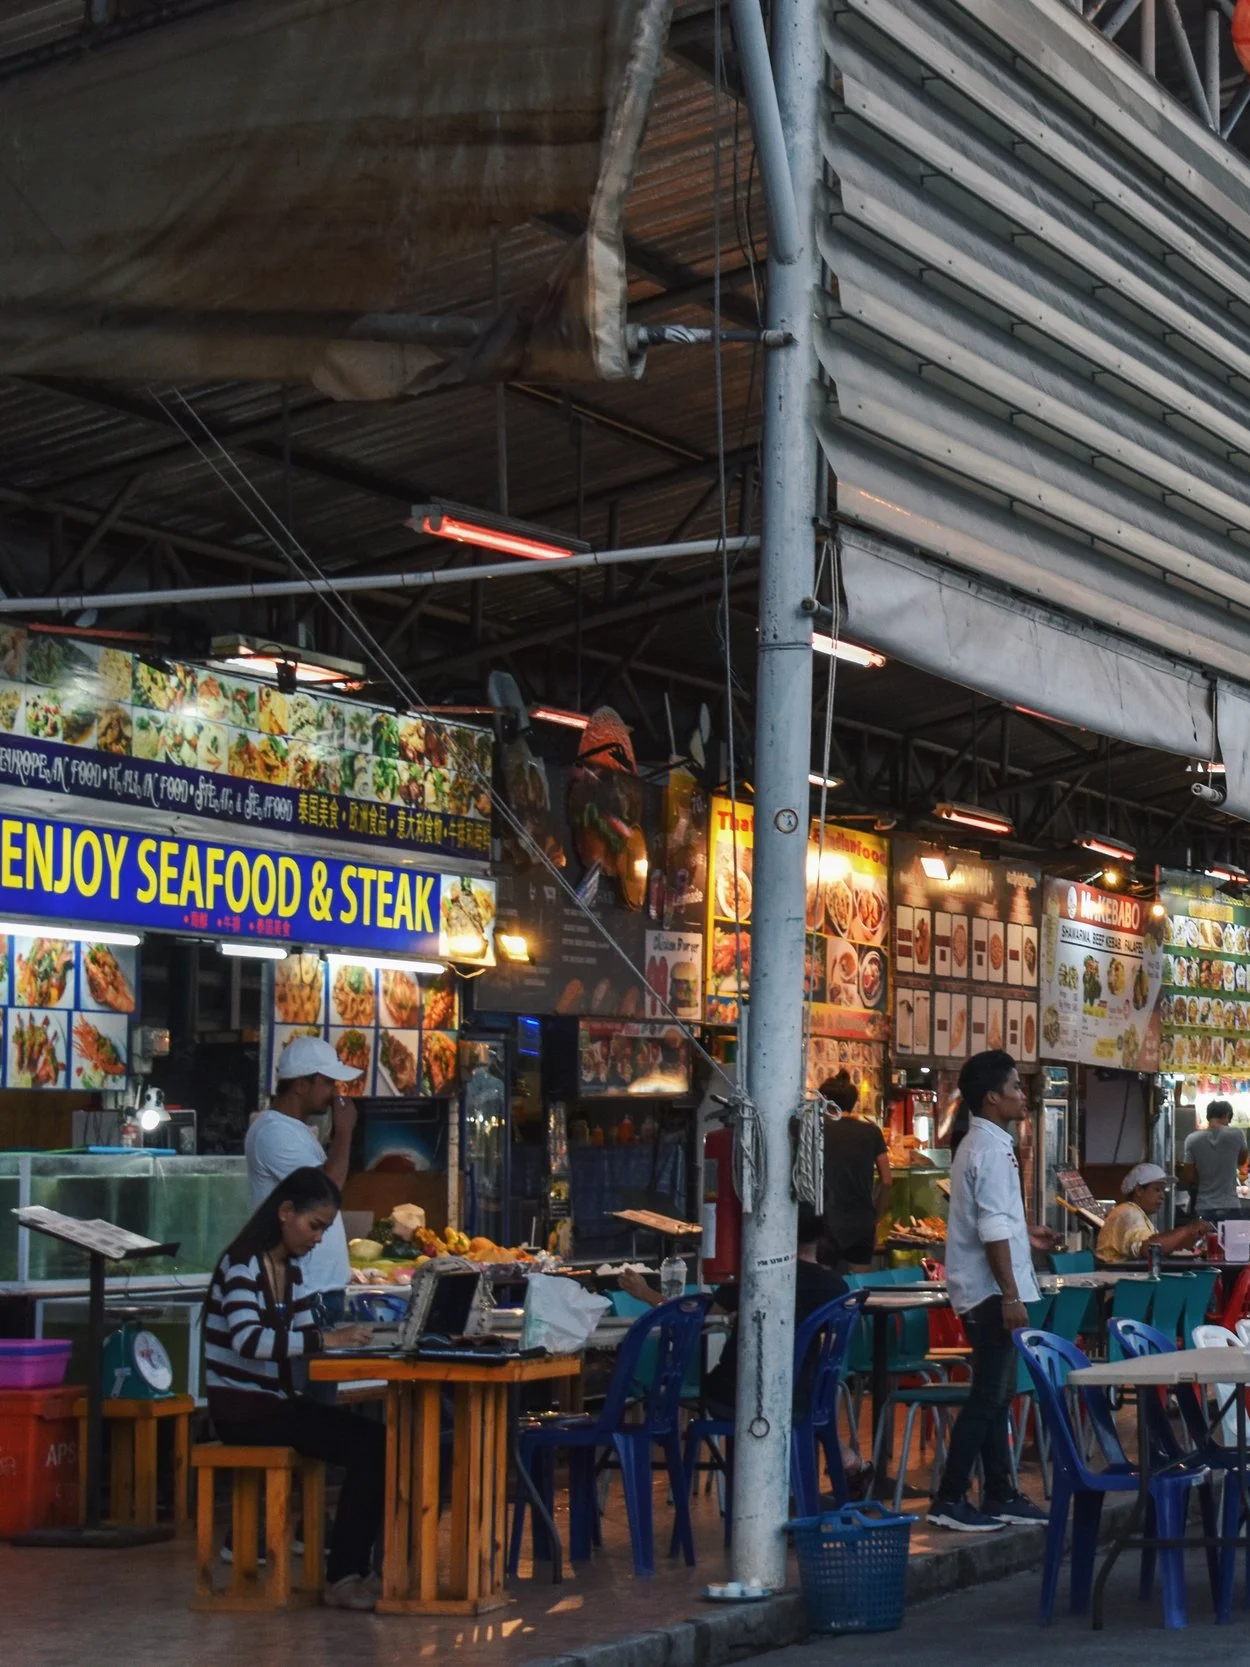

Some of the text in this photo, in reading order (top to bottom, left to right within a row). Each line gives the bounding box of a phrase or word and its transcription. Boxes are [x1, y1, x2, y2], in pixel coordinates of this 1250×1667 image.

[71, 760, 101, 788] FOOD
[160, 775, 189, 804] FOOD
[2, 819, 435, 934] ENJOY SEAFOOD & STEAK
